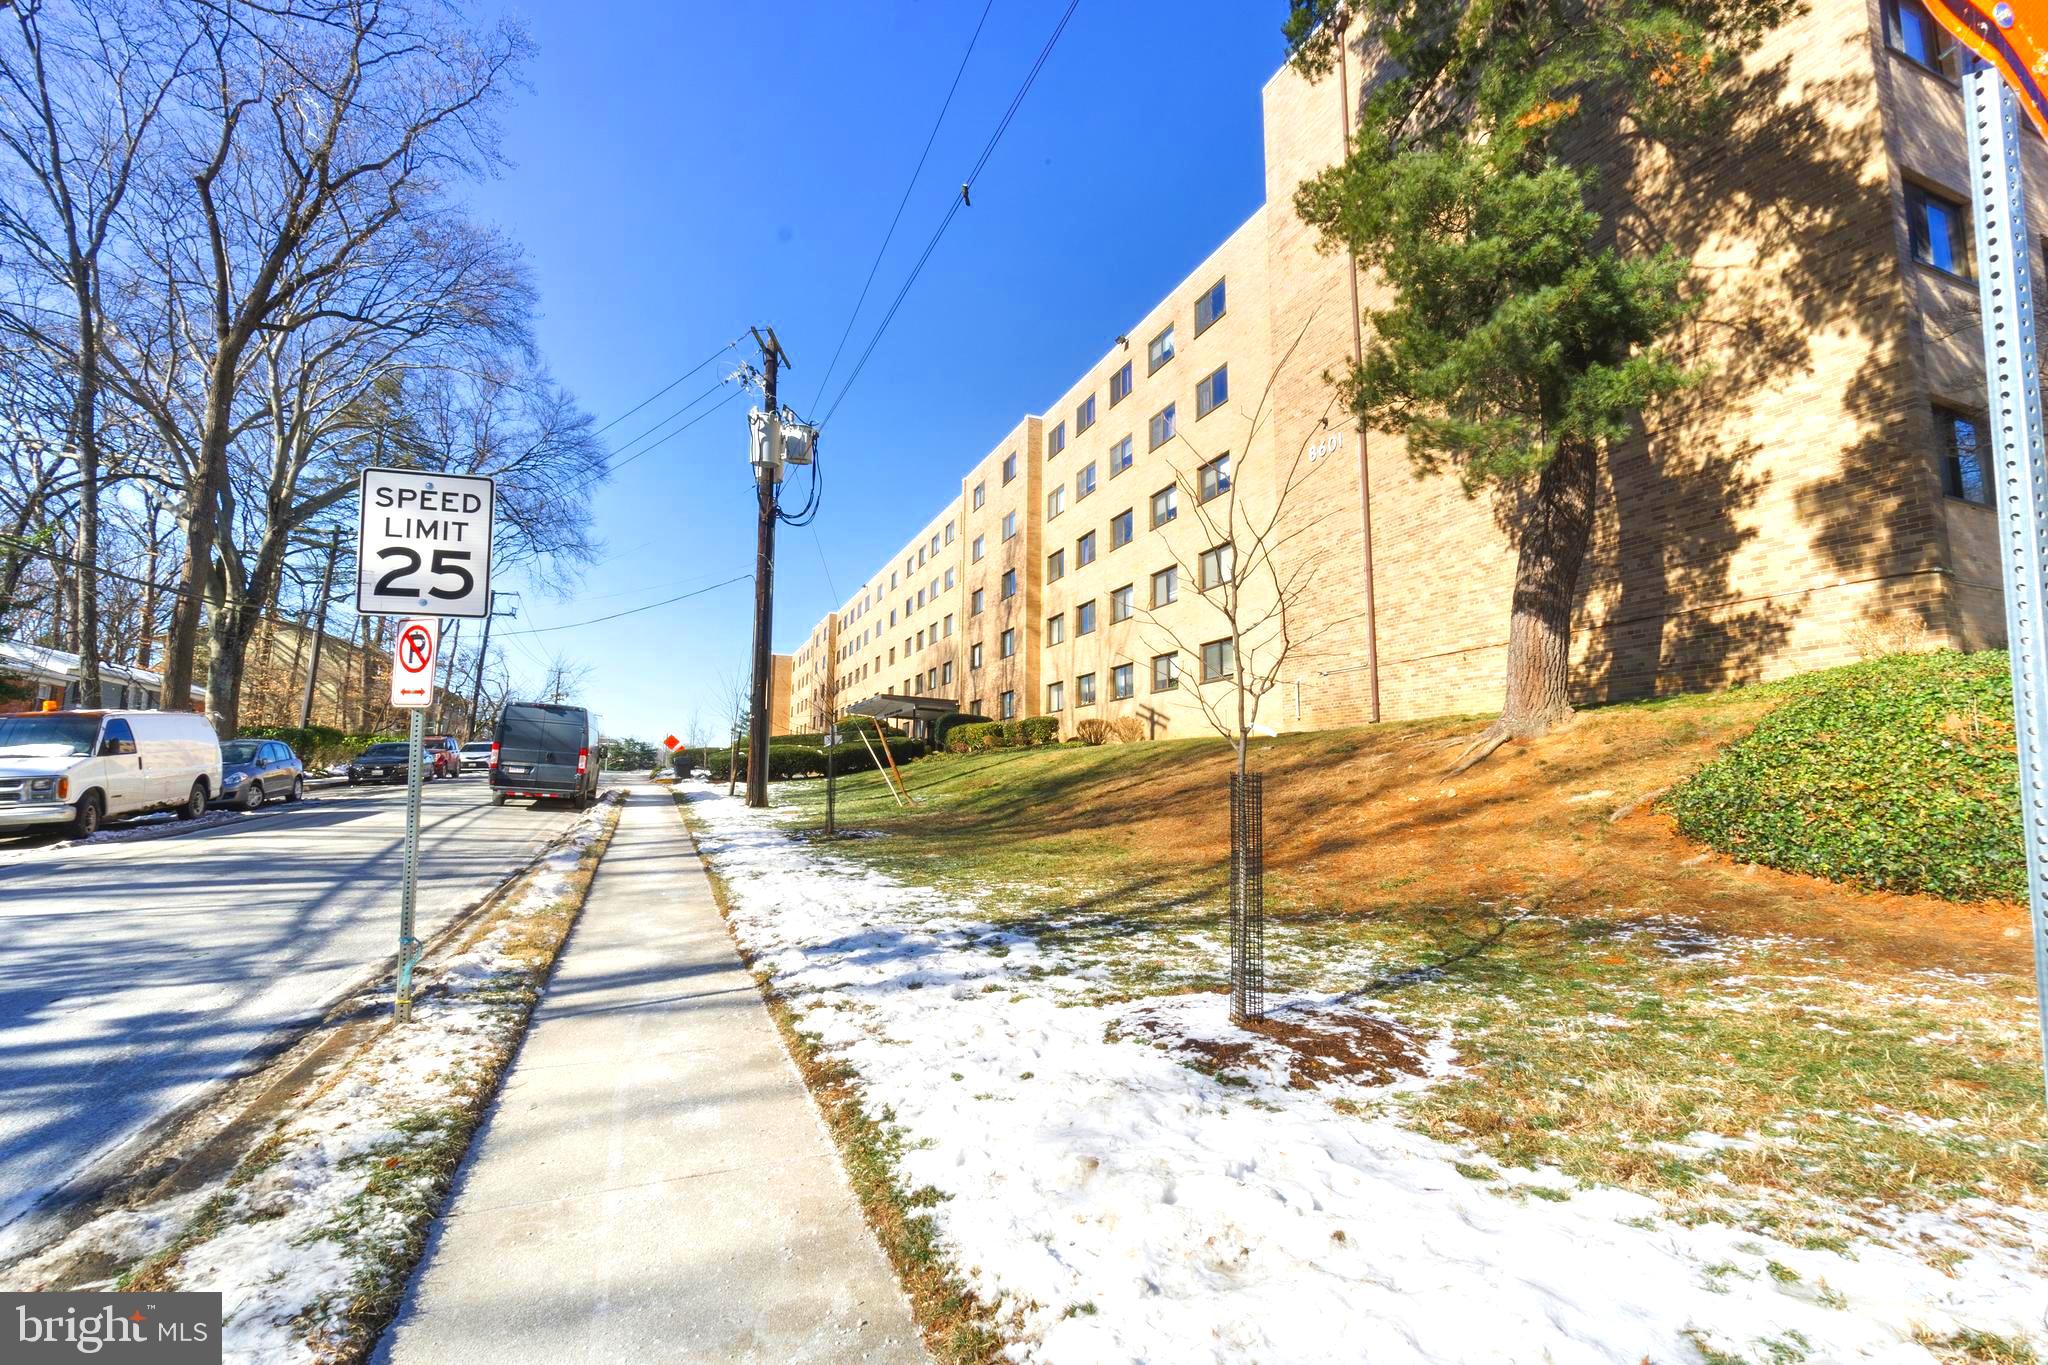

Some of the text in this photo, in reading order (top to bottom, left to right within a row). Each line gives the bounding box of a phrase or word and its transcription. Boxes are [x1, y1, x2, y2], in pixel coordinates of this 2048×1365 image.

[1309, 431, 1343, 463] 8601
[375, 486, 482, 514] SPEED
[385, 516, 469, 542] LIMIT
[373, 546, 475, 600] 25
